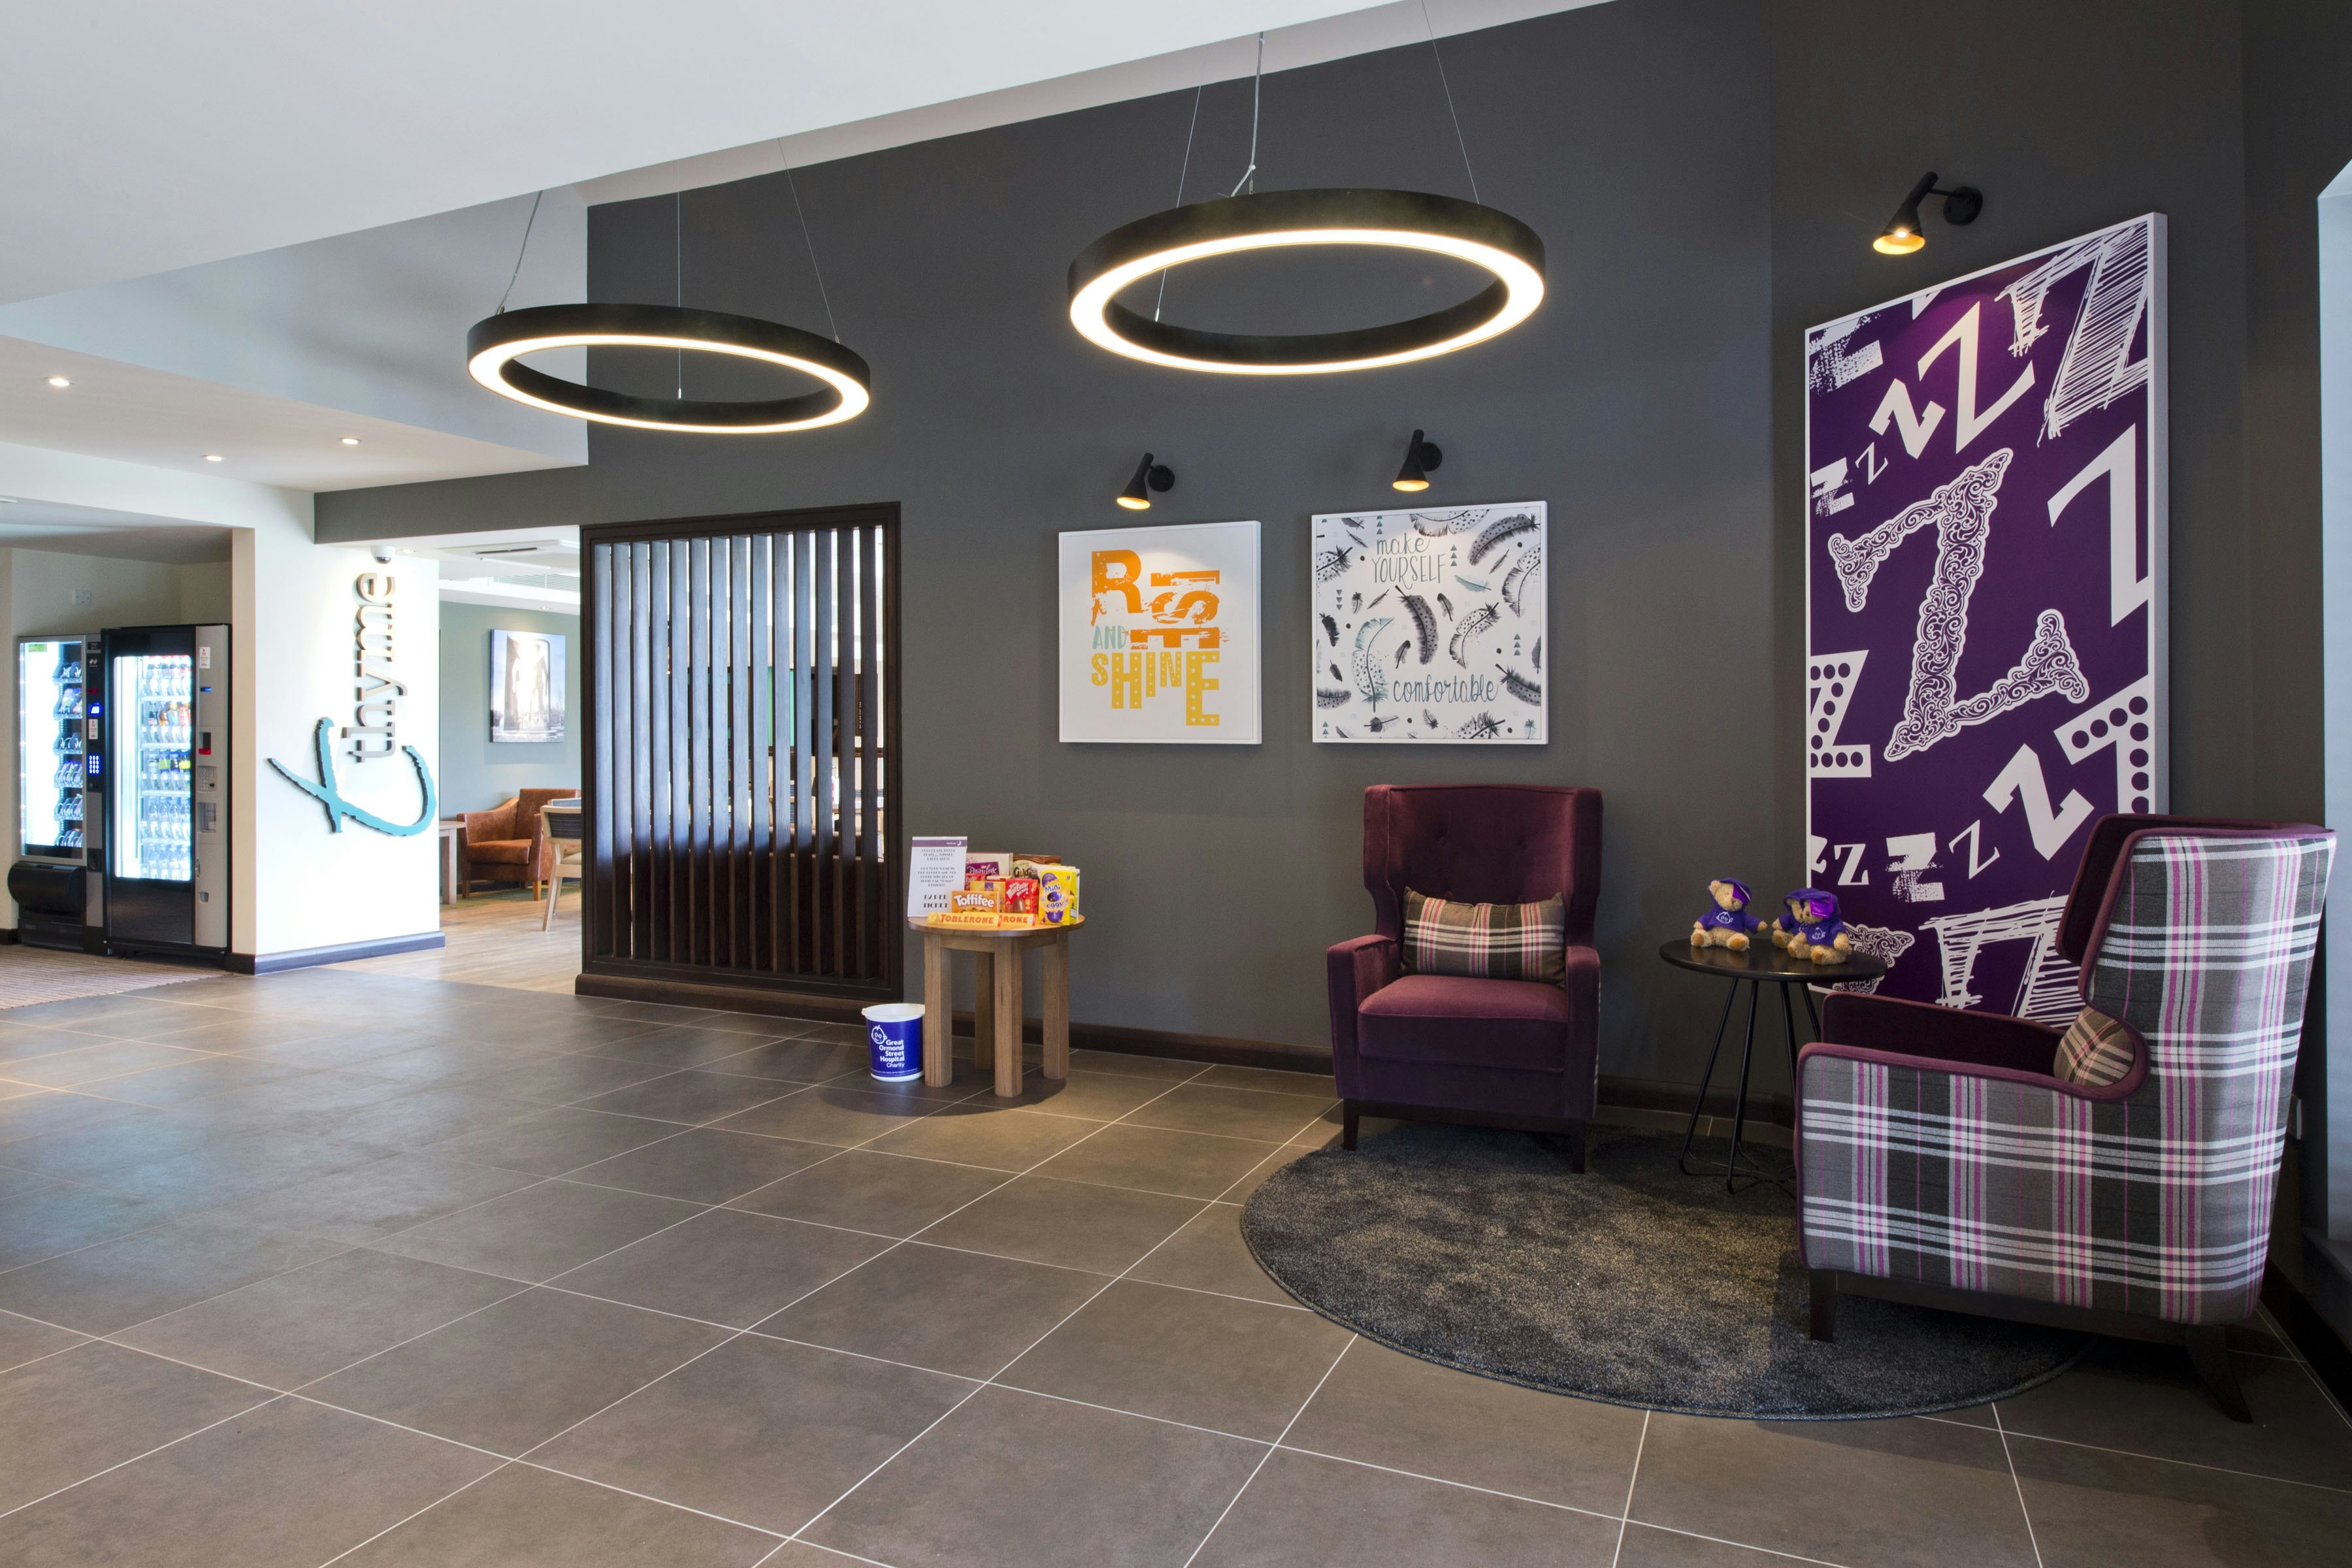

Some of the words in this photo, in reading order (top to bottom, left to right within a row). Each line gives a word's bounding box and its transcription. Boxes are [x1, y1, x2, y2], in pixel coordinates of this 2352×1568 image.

[1377, 533, 1429, 555] make
[1371, 553, 1446, 590] YOURSELF
[1092, 625, 1127, 650] AND
[341, 572, 408, 763] thyme
[1091, 651, 1220, 726] SHINE
[1394, 674, 1501, 703] comfortable
[954, 893, 994, 907] Toffifee
[1045, 883, 1060, 892] Mini
[940, 914, 994, 924] TOBLERONE
